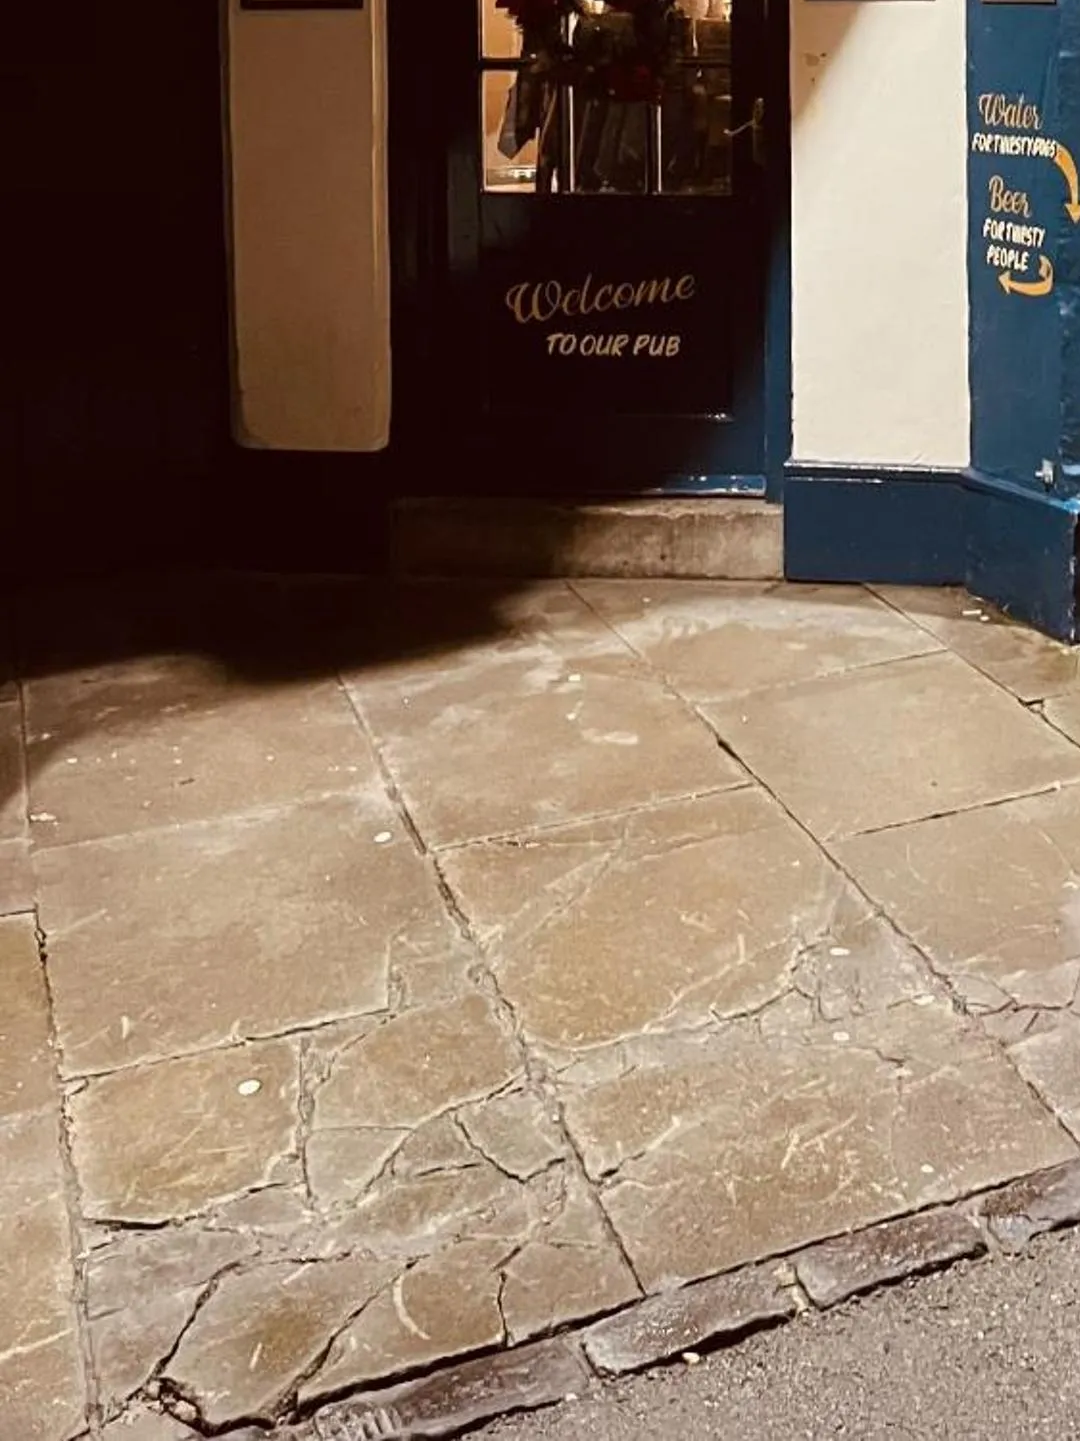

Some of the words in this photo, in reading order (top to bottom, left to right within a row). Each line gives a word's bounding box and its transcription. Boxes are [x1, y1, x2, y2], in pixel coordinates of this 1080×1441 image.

[978, 92, 1044, 130] Water
[971, 132, 993, 152] FOR
[989, 174, 1031, 218] Beer
[983, 218, 1005, 240] FOR
[986, 244, 1030, 272] PEOPLE
[505, 272, 696, 323] Welcome
[546, 333, 577, 356] TO
[579, 333, 629, 356] OUR
[633, 333, 681, 357] PUB
